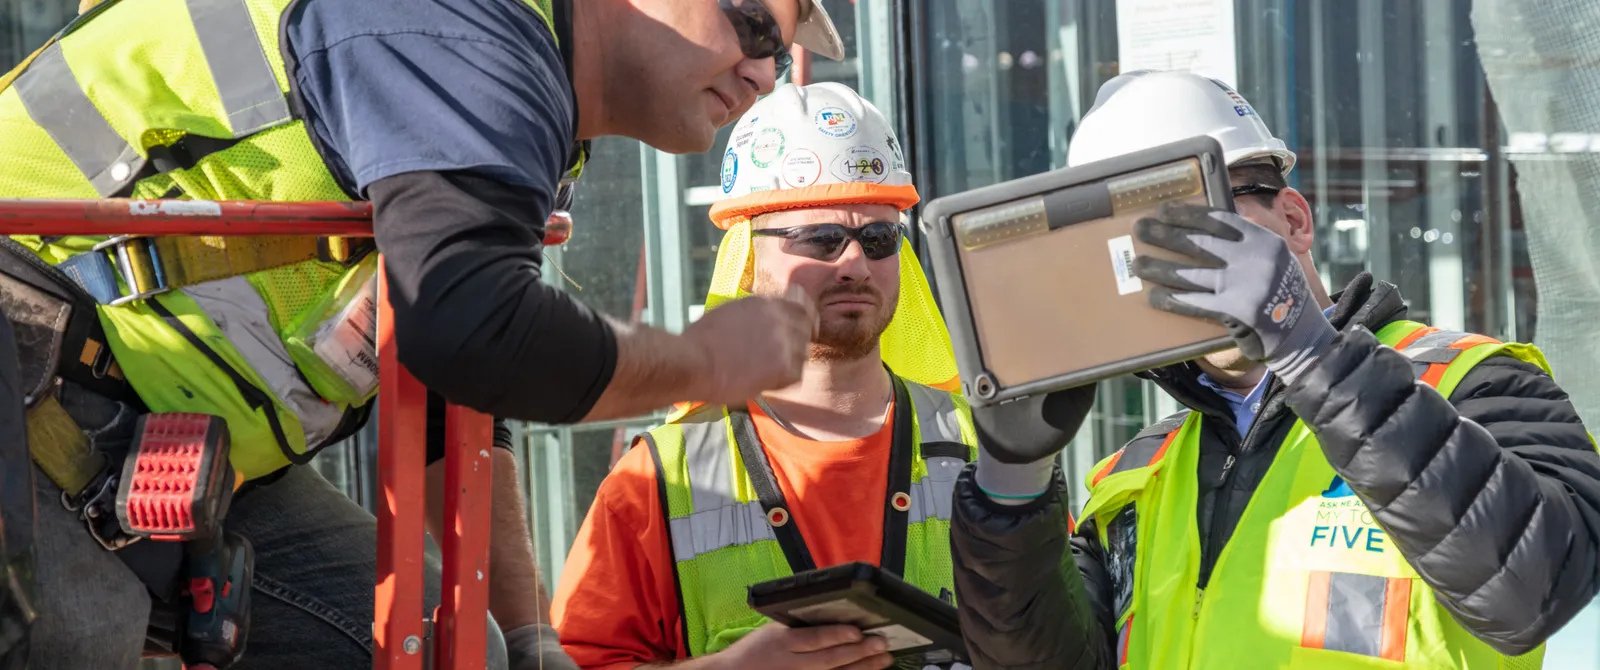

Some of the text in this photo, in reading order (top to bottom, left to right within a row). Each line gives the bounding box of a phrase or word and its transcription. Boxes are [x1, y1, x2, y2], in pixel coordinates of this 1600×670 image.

[818, 126, 834, 137] SAFETY
[1316, 510, 1342, 525] MY
[1310, 525, 1385, 553] FIVE
